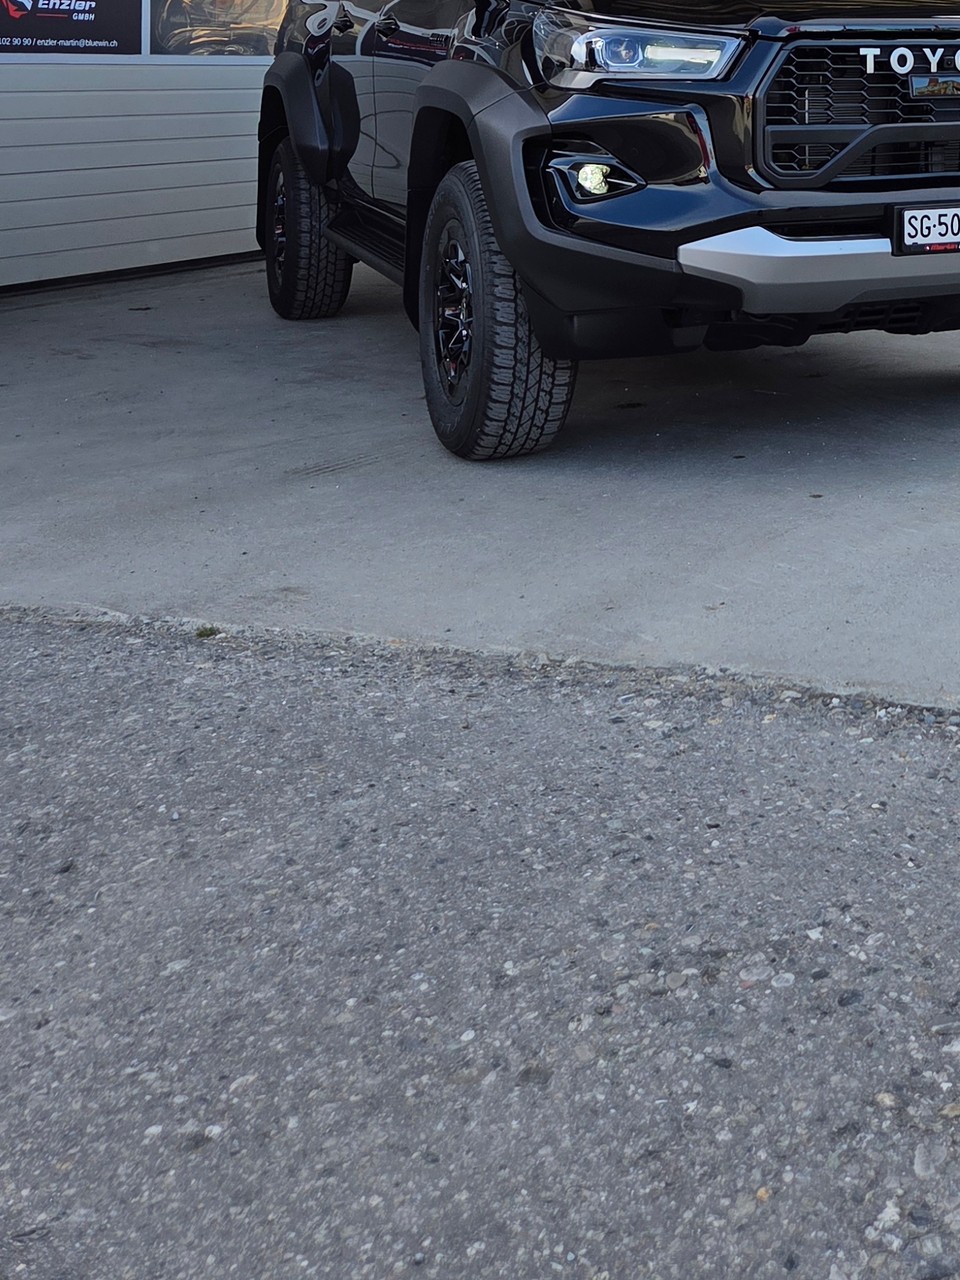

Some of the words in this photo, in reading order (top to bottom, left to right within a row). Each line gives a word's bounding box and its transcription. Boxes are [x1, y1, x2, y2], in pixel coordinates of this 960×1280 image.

[12, 37, 22, 47] 90
[22, 37, 32, 47] 90
[36, 37, 118, 49] enzler-martin@bluewin.ch
